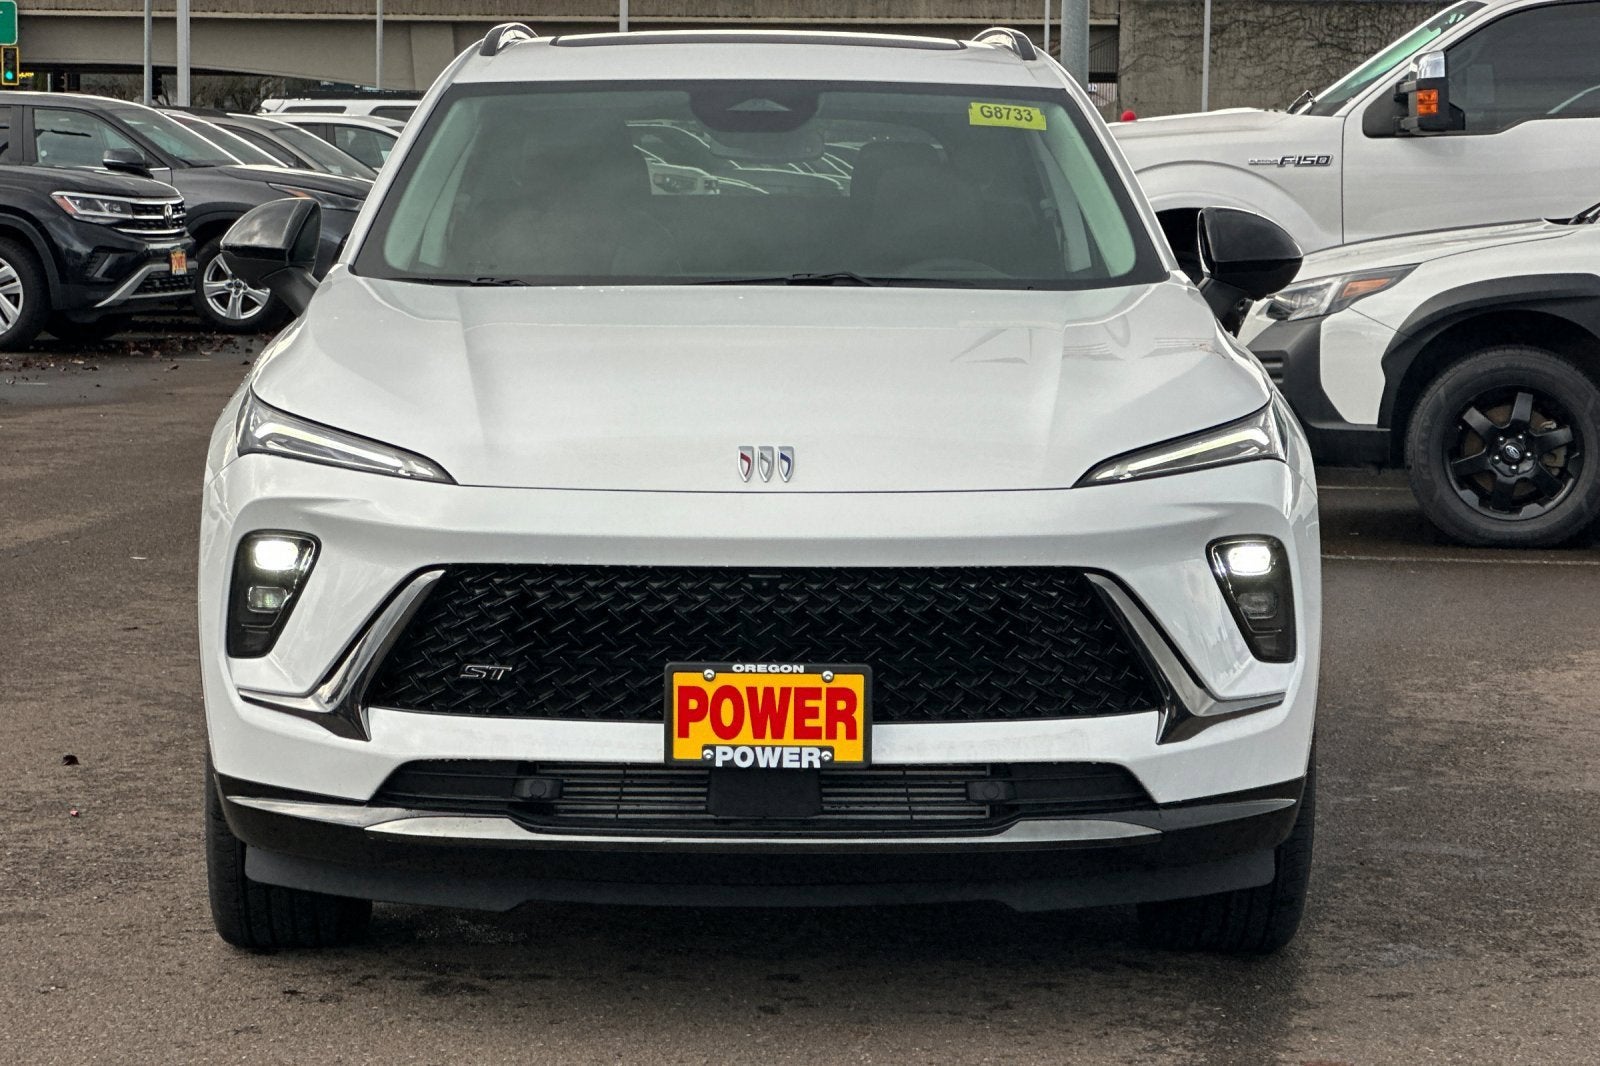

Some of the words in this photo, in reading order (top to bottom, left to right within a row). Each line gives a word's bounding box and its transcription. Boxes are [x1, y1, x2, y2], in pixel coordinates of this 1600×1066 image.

[980, 105, 1033, 122] G8733
[460, 665, 512, 681] ST
[732, 664, 804, 674] OREGON
[677, 684, 858, 740] POWER
[715, 746, 821, 768] POWER
